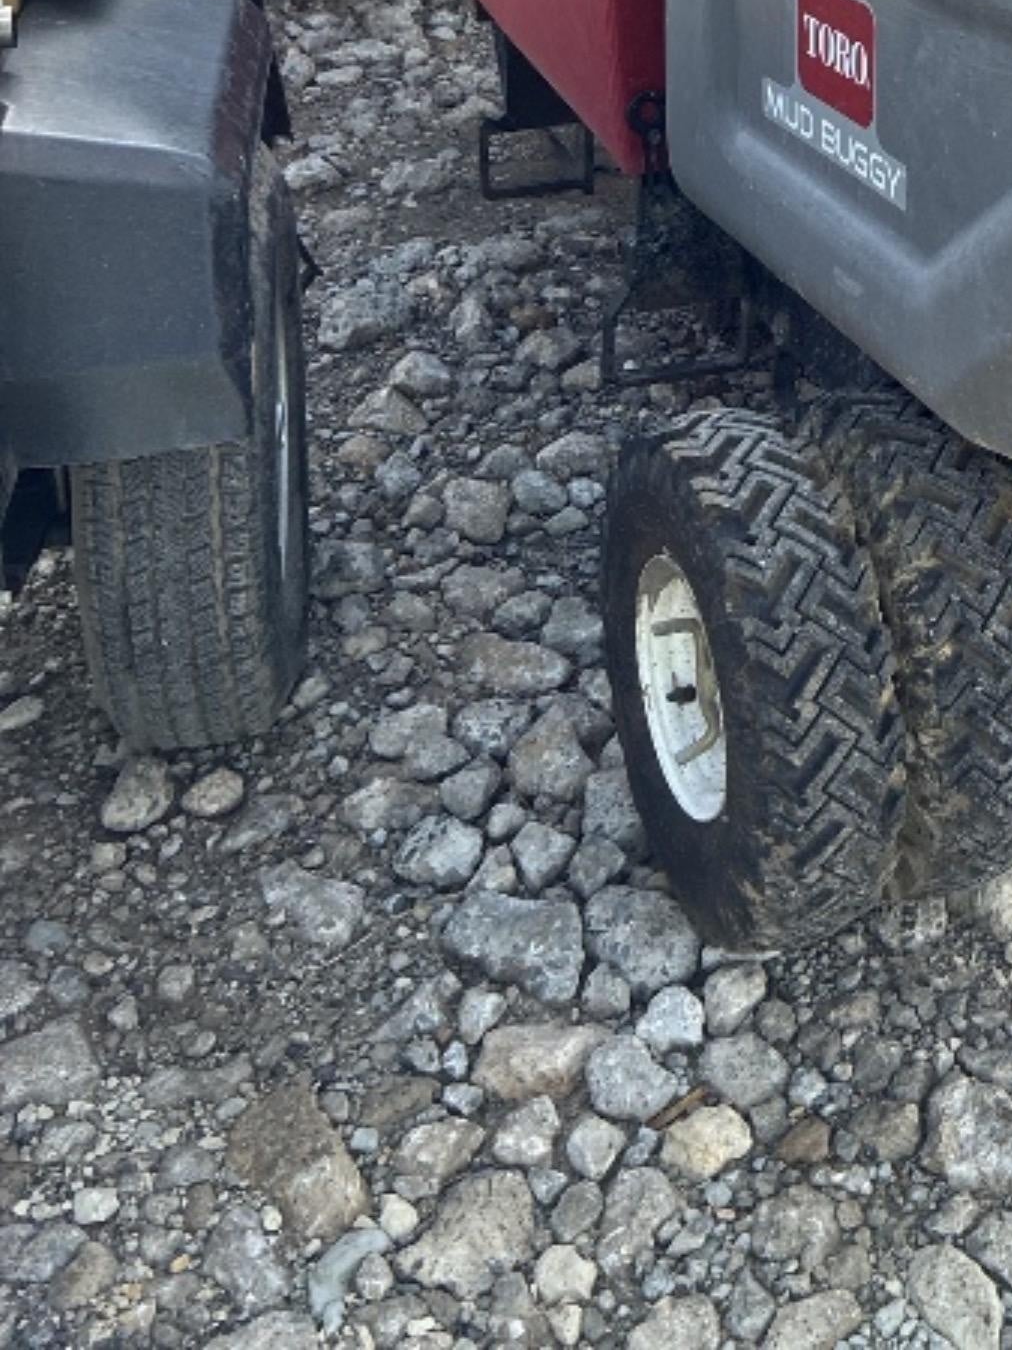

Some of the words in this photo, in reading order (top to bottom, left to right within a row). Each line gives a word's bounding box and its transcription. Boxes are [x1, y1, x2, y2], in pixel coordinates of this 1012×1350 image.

[804, 13, 869, 86] TORO
[766, 82, 814, 139] MUD
[821, 118, 903, 199] BUGGY
